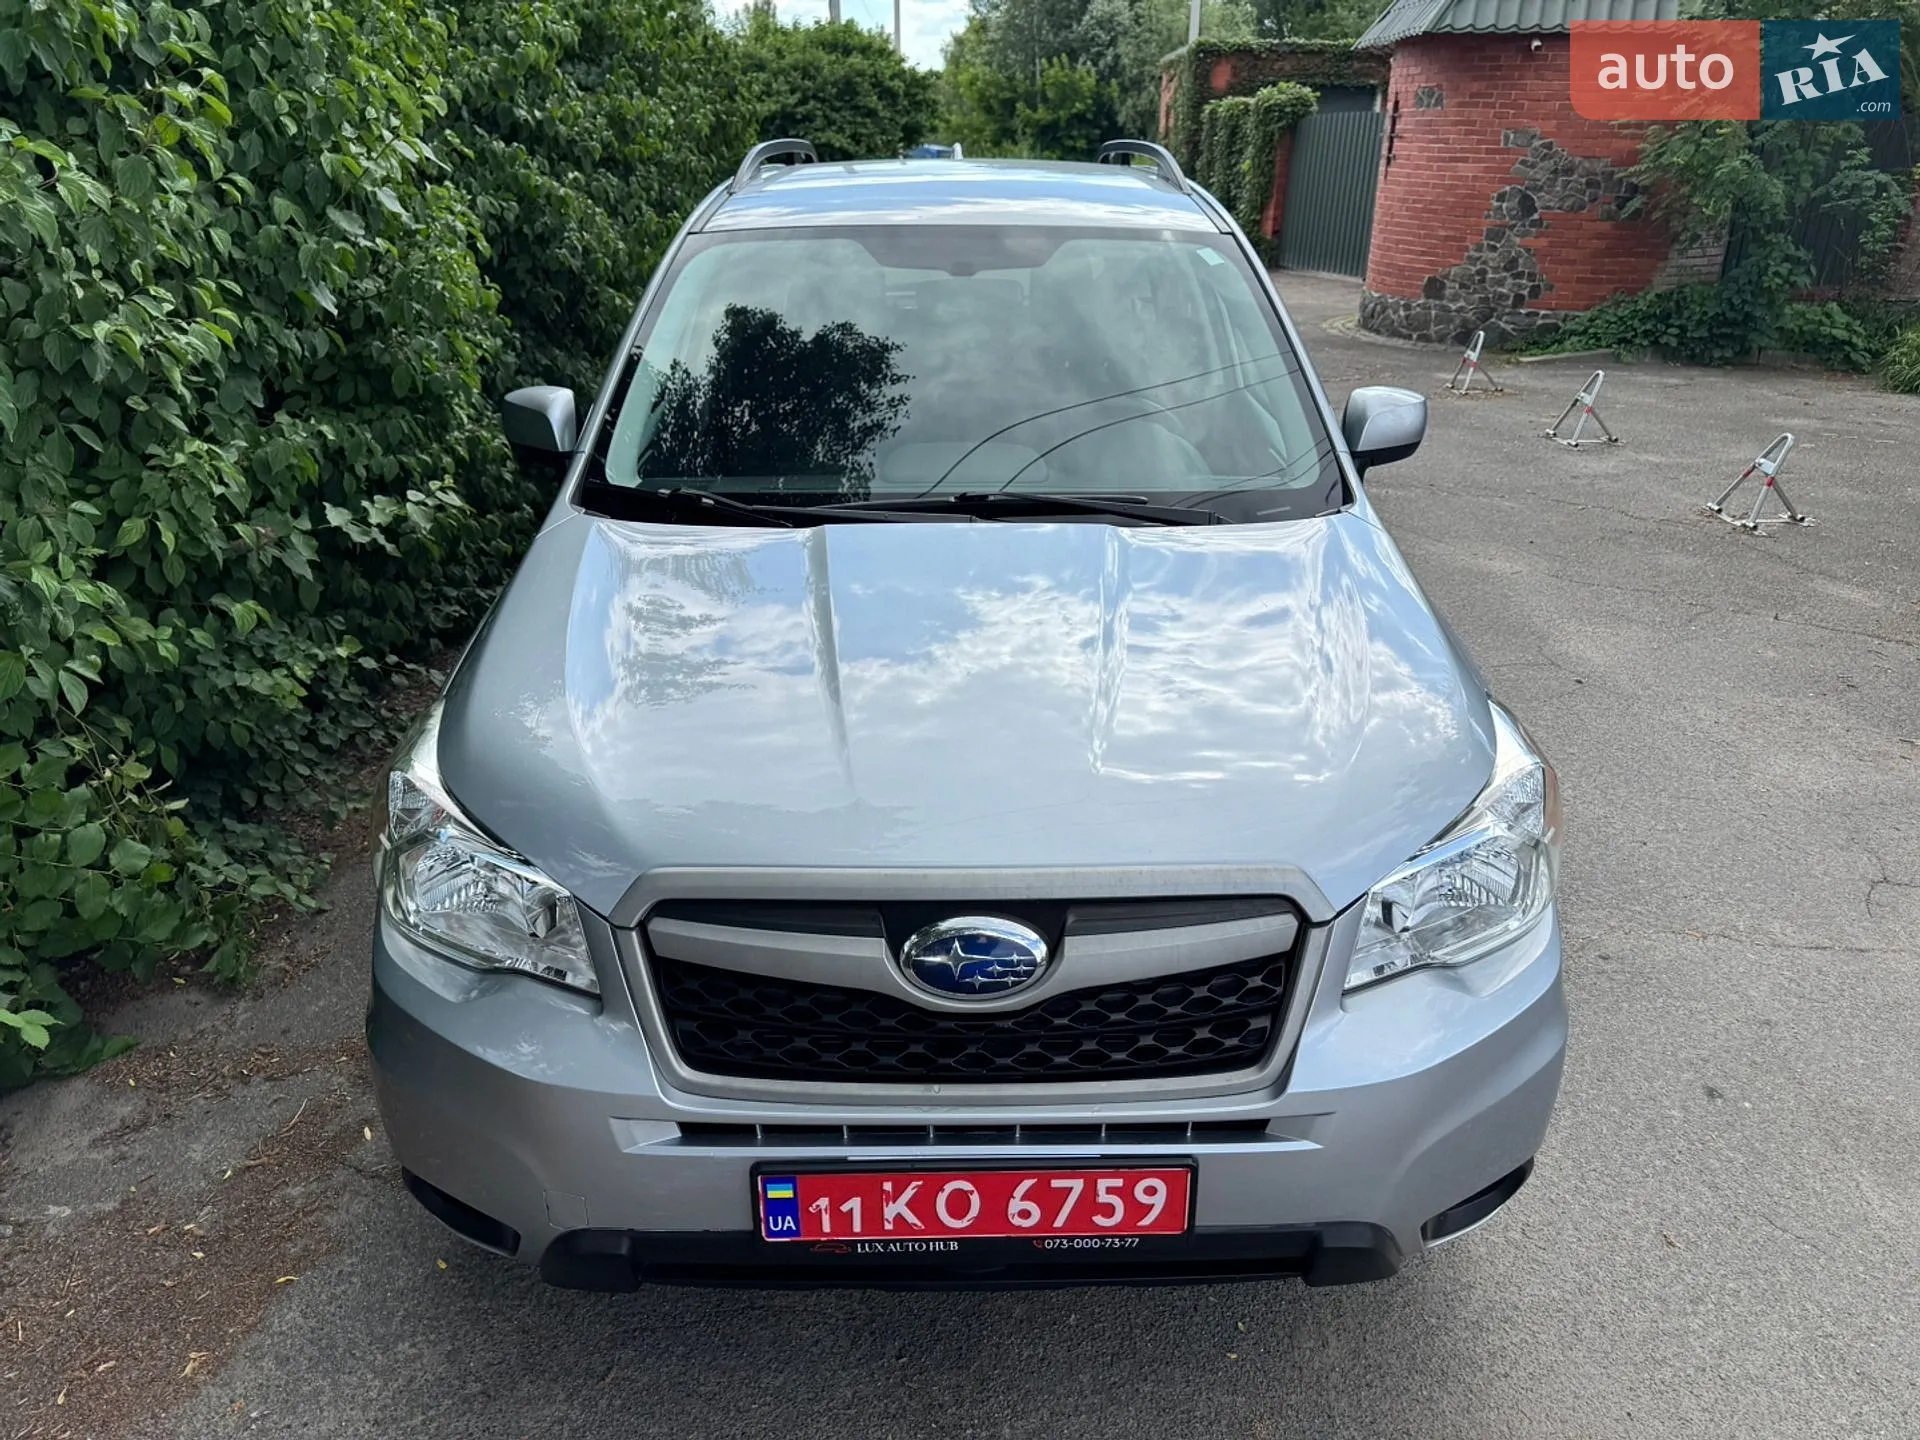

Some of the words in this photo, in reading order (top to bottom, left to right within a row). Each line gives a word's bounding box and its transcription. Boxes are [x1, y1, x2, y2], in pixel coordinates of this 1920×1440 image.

[1007, 1177, 1168, 1228] 6759
[769, 1215, 797, 1231] UA
[856, 1242, 886, 1254] LUX
[886, 1241, 927, 1253] AUTO
[929, 1240, 959, 1252] HUB
[1044, 1237, 1140, 1250] 073-000-73-77
